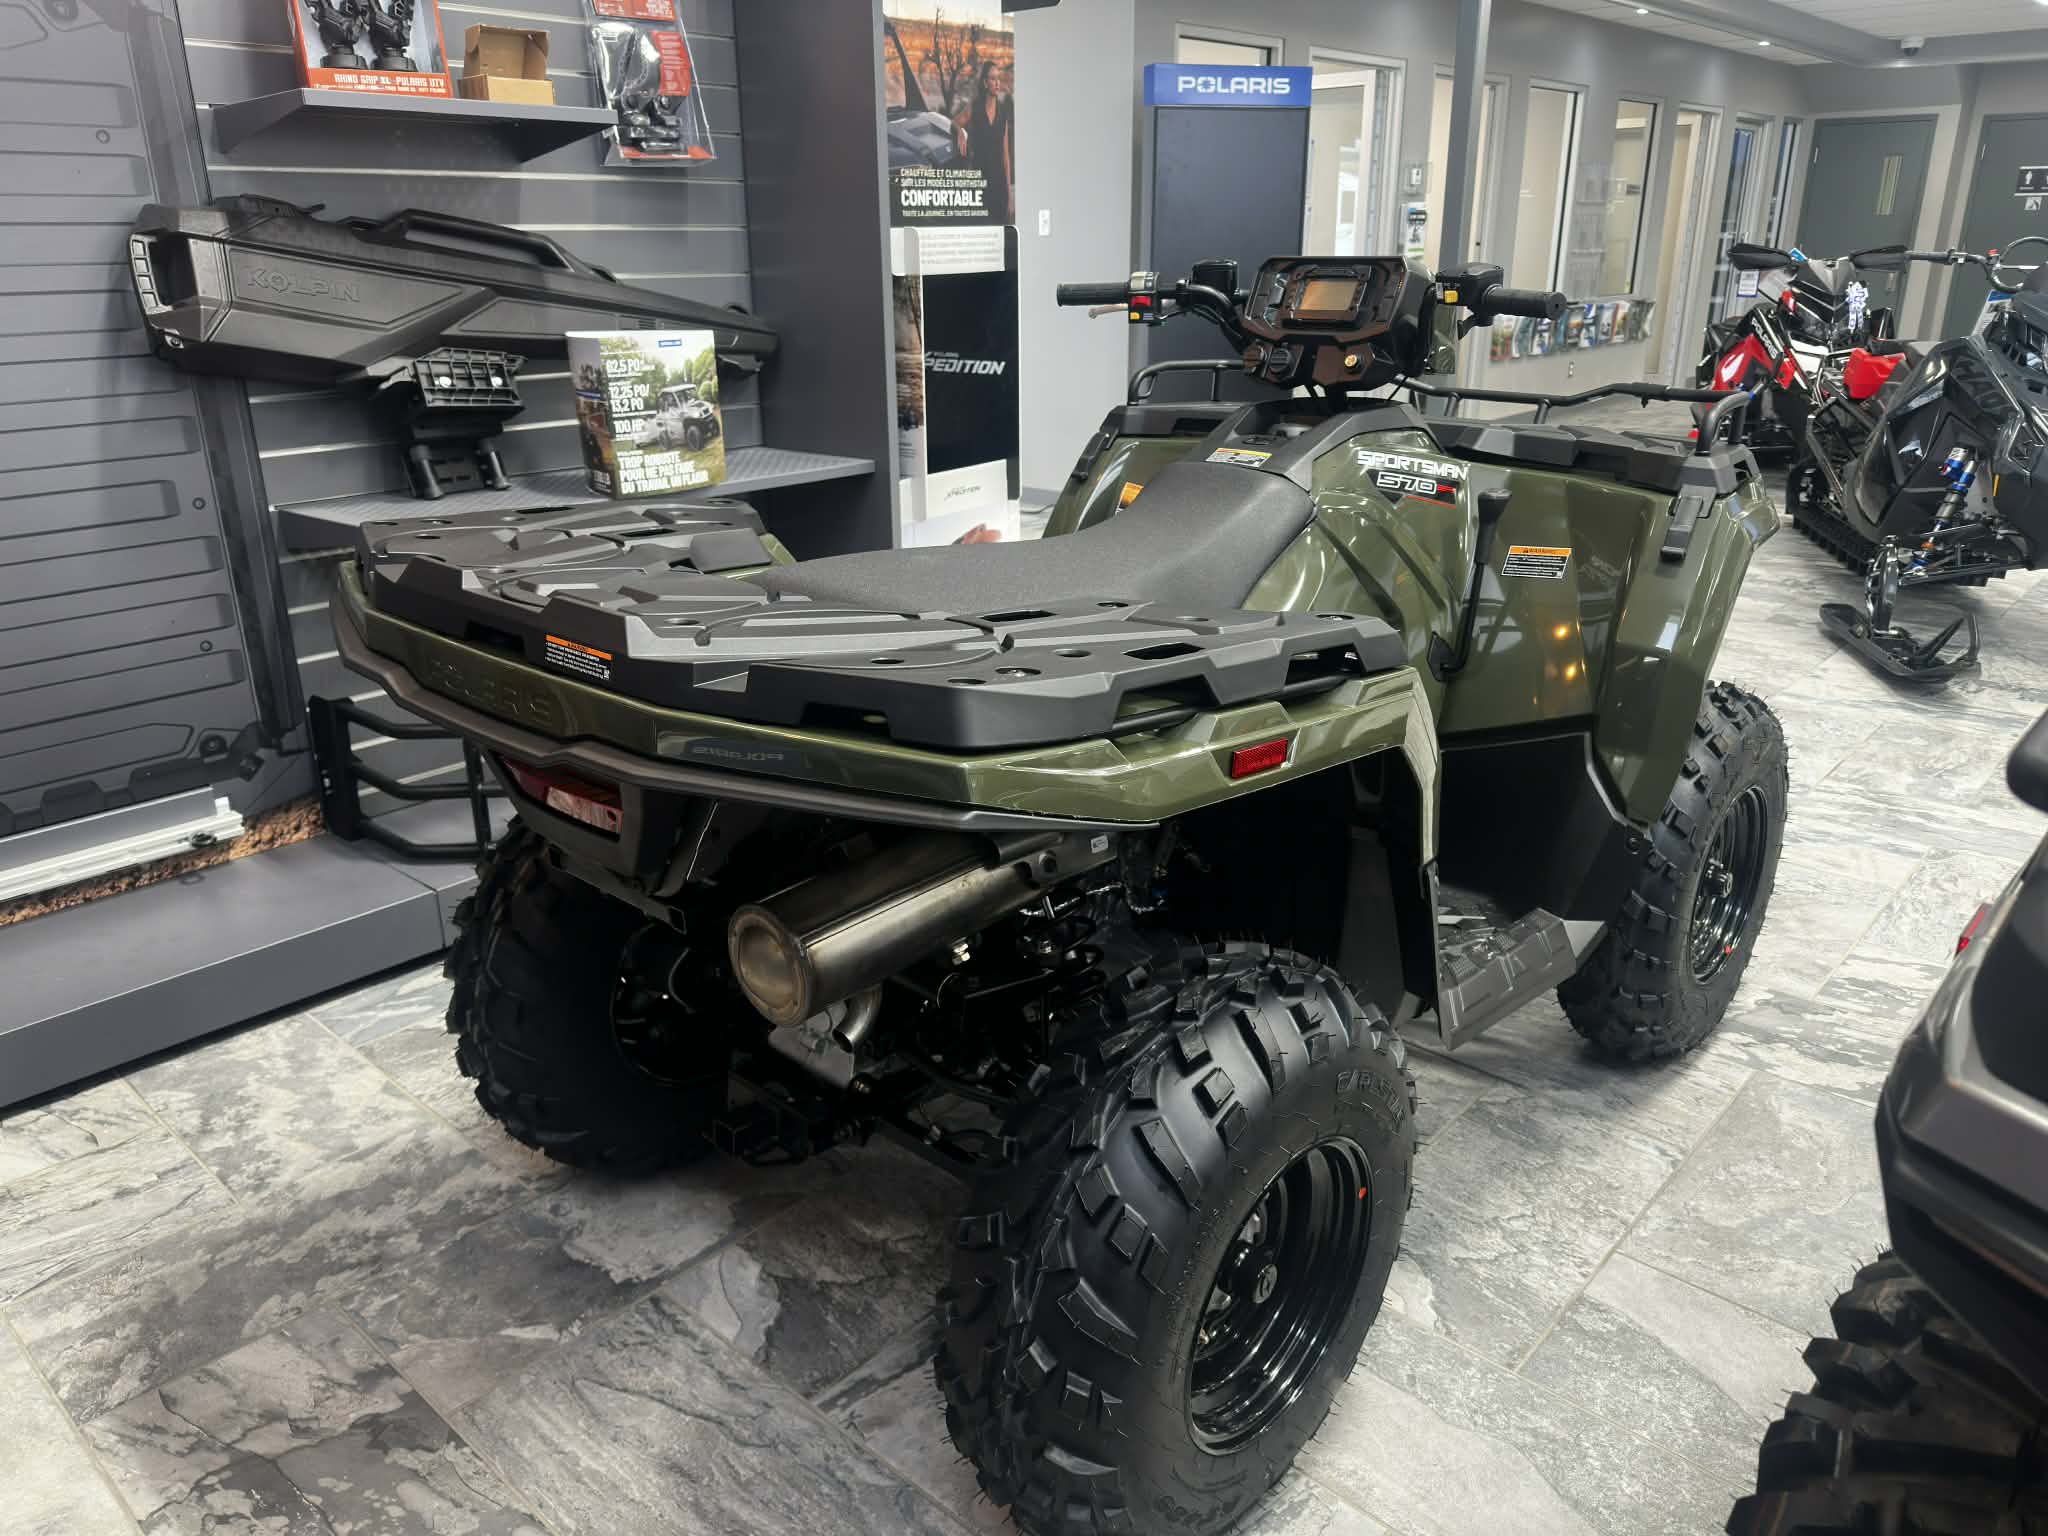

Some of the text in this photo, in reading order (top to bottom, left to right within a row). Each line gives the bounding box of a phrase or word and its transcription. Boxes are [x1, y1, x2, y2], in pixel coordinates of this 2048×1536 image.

[360, 74, 378, 84] GRIP
[395, 76, 427, 87] POLARIS
[1178, 76, 1291, 94] POLARIS
[937, 169, 944, 178] ET
[914, 178, 926, 187] LES
[901, 189, 983, 207] CONFORTABLE
[247, 266, 361, 302] KOLPIN
[1751, 317, 1778, 359] POLARIS
[631, 397, 644, 411] PO
[613, 418, 644, 434] 100 HP
[617, 455, 643, 470] TROP
[1358, 450, 1469, 481] SPORTSMAN
[619, 467, 645, 482] POUR
[658, 463, 674, 478] PAS
[621, 480, 636, 495] DU
[1376, 471, 1438, 495] 570
